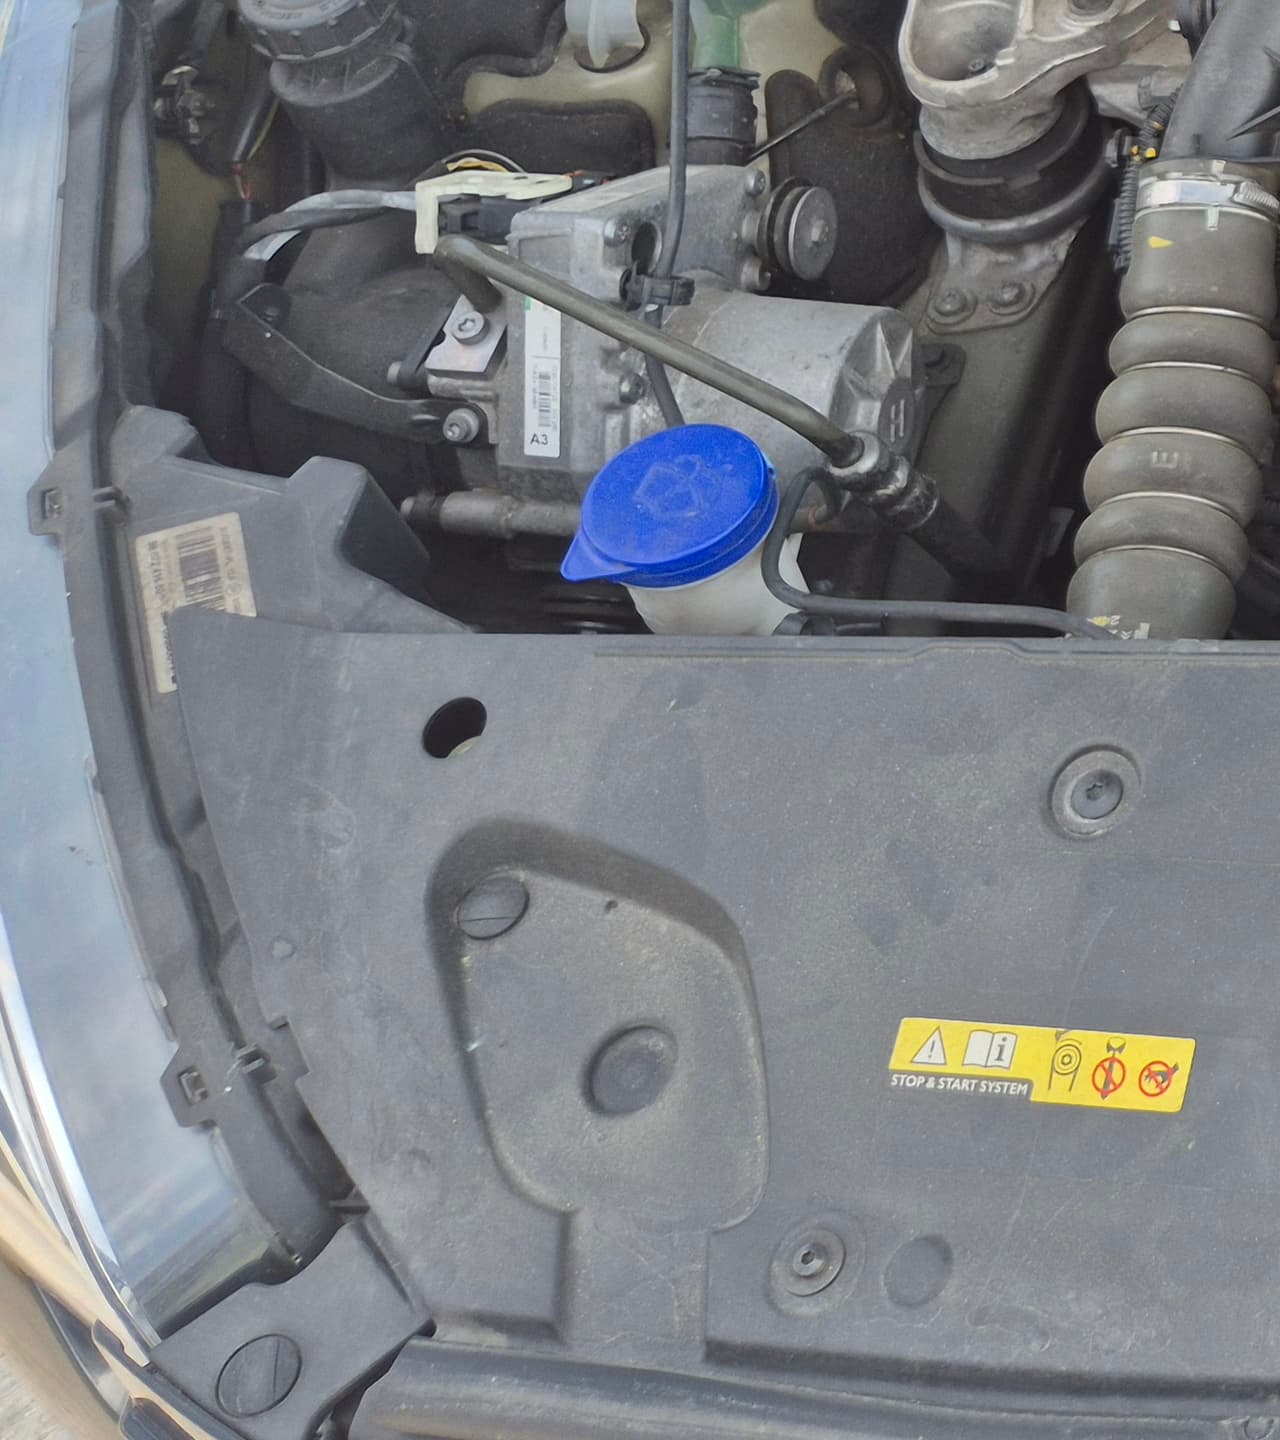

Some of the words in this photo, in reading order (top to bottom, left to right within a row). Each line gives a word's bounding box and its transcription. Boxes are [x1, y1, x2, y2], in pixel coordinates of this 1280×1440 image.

[529, 433, 550, 446] A3
[890, 1073, 926, 1088] STOP
[925, 1076, 936, 1089] &
[937, 1076, 978, 1092] START
[978, 1079, 1030, 1096] SYSTEM
